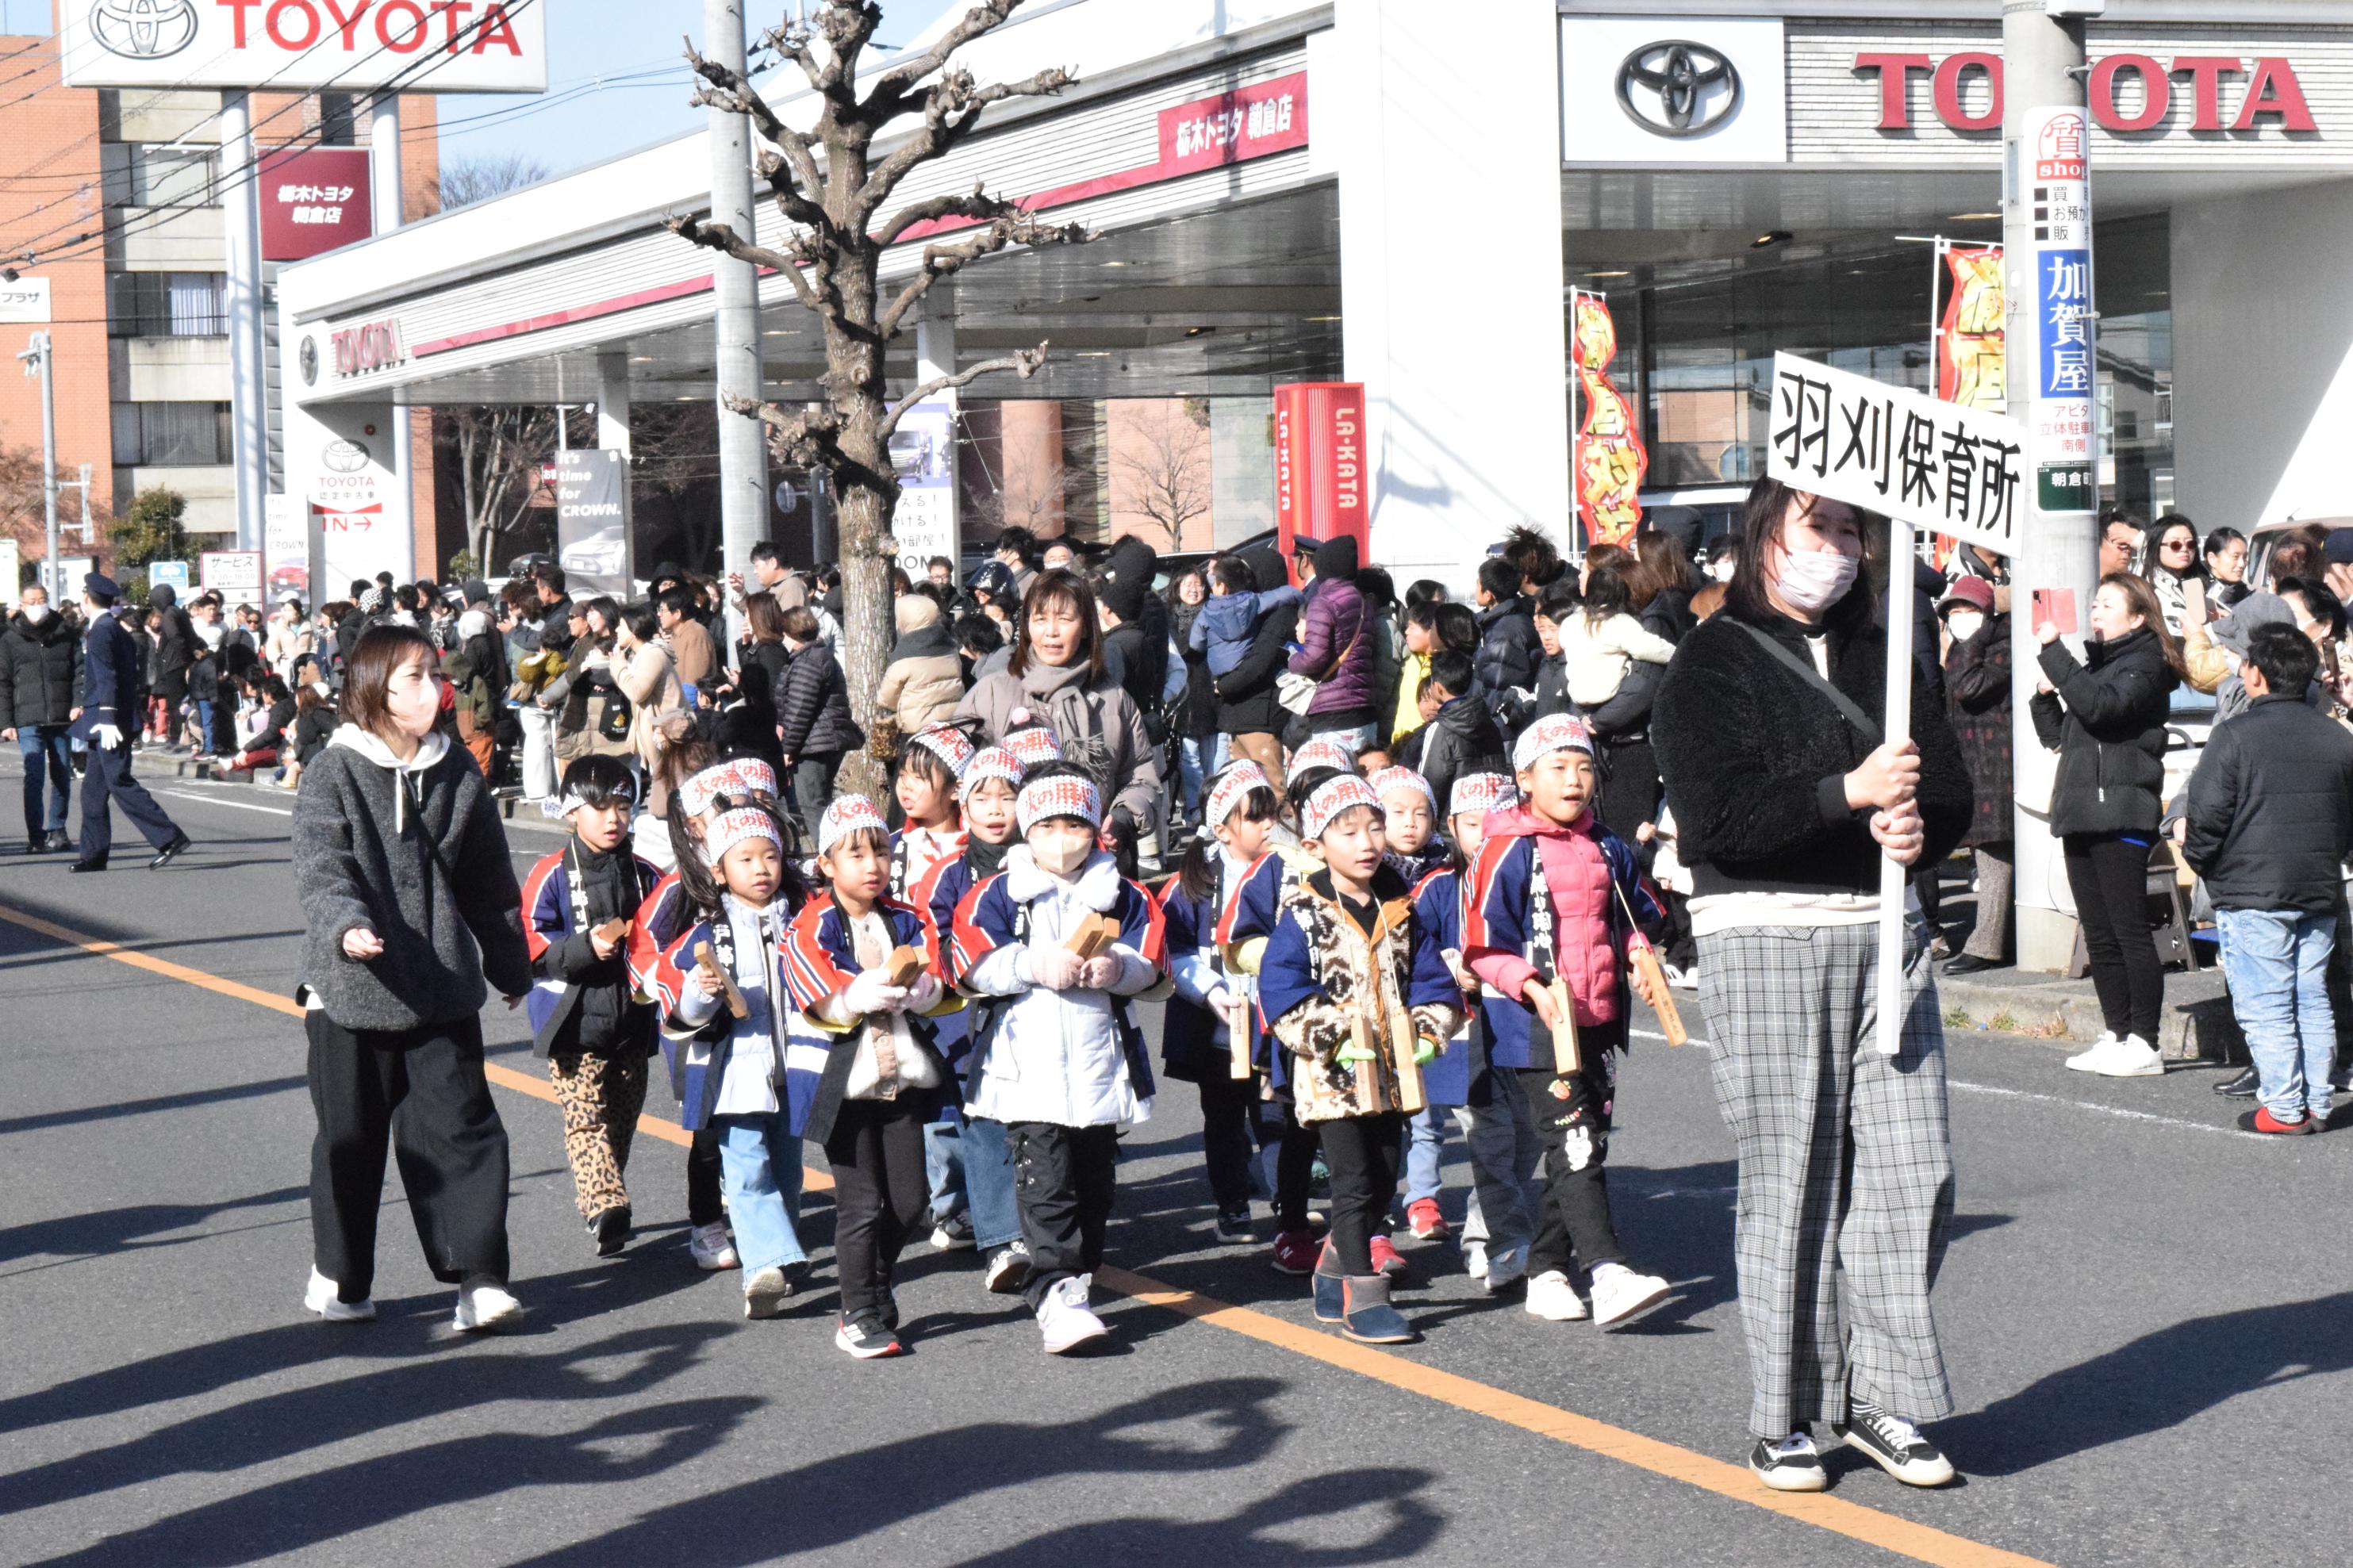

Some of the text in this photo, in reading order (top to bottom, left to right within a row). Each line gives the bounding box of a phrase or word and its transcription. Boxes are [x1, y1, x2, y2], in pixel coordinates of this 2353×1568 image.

[217, 0, 524, 57] TOYOTA
[1852, 51, 2318, 133] TOOTA
[1246, 94, 1294, 141] 朝倉店
[2044, 121, 2086, 159] 質
[2047, 256, 2089, 393] 加賀屋
[332, 318, 400, 374] TOYOTA
[2053, 404, 2089, 418] アピタ
[2040, 421, 2095, 437] 立体駐車
[1773, 370, 2021, 539] 羽刈保育所
[2061, 438, 2086, 453] 南側
[319, 477, 375, 488] TOYOTA
[559, 470, 593, 482] time
[2051, 471, 2093, 488] 朝倉町
[319, 491, 375, 500] 認定中古車
[559, 487, 582, 500] for
[561, 504, 622, 517] CROWN.
[323, 517, 347, 533] IN
[210, 556, 254, 569] サービス
[1532, 719, 1587, 749] 火の用
[693, 768, 748, 803] 火の用
[1026, 780, 1094, 817] 火の用心
[1456, 776, 1501, 804] 火の用
[721, 811, 774, 839] 火の用
